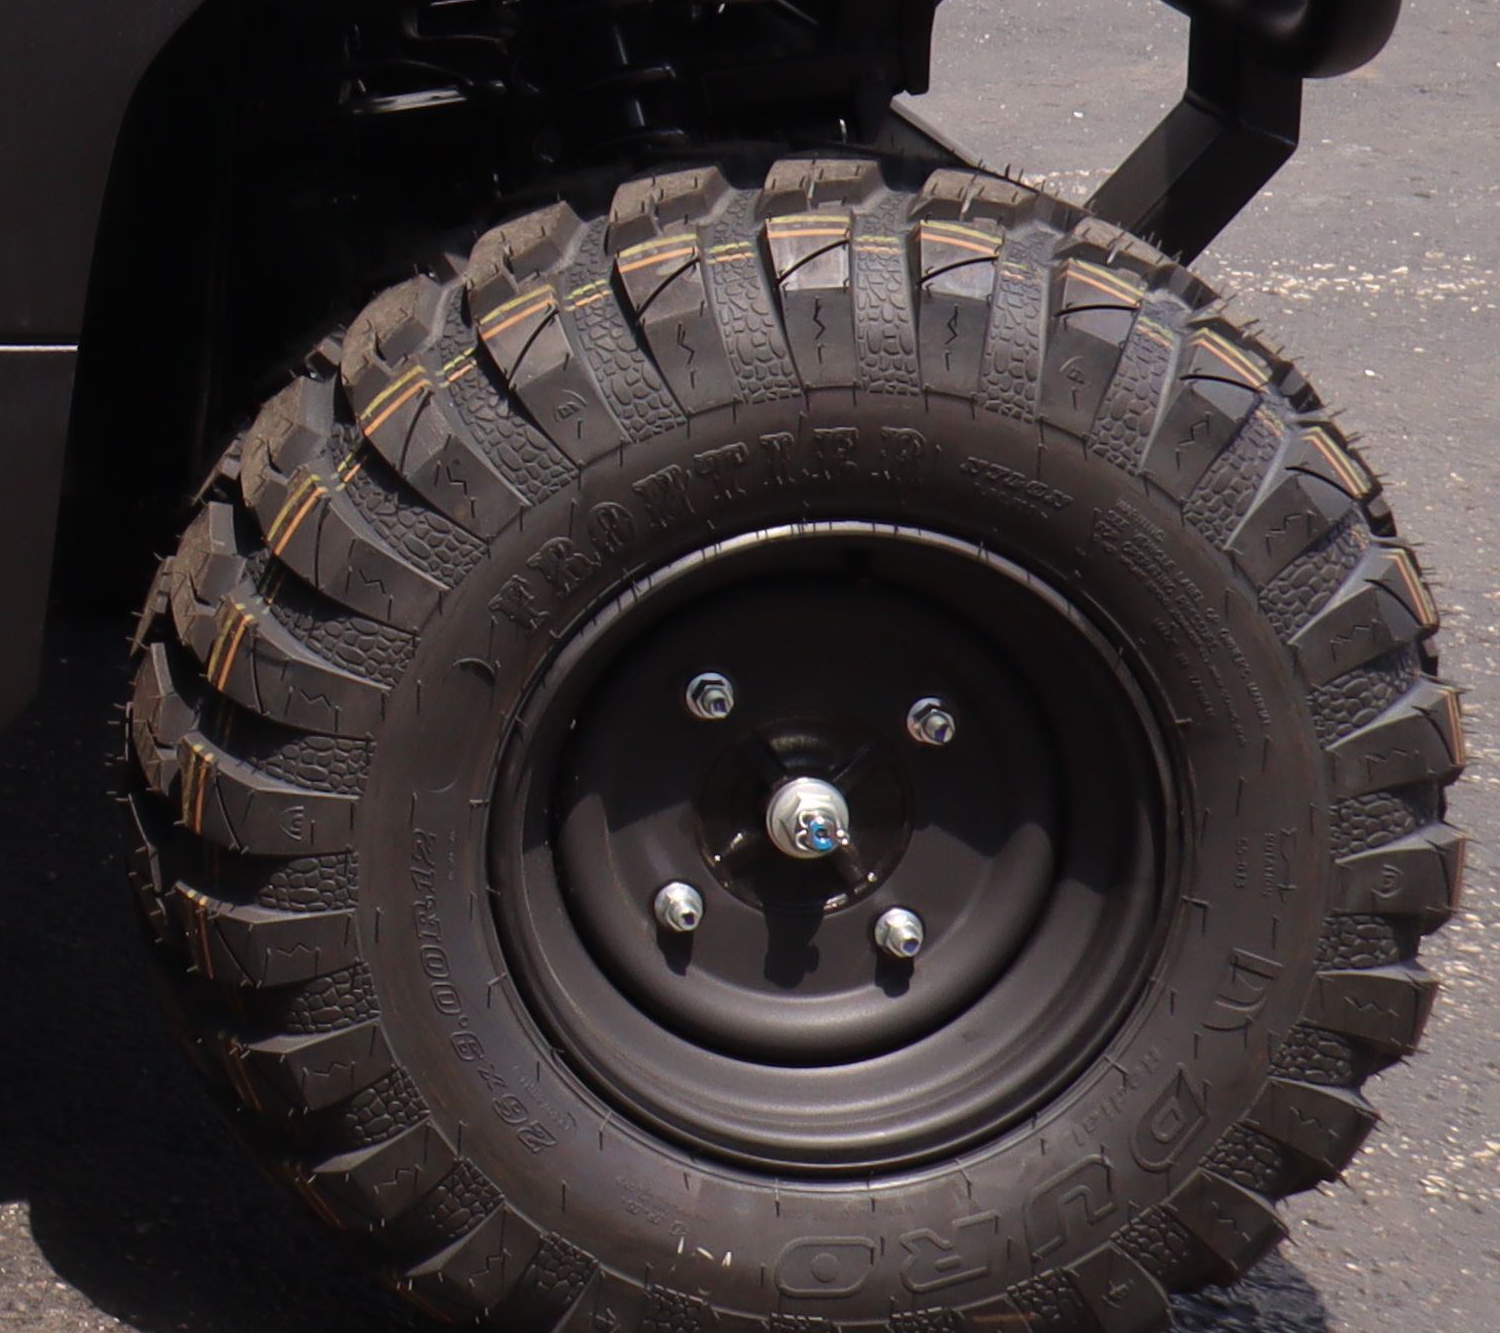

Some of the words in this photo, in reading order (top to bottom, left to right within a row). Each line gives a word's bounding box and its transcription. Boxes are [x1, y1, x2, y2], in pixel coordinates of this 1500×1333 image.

[496, 426, 932, 635] FRONTIER
[410, 829, 557, 1160] 26x9.00R12
[774, 1063, 1208, 1298] DURO
